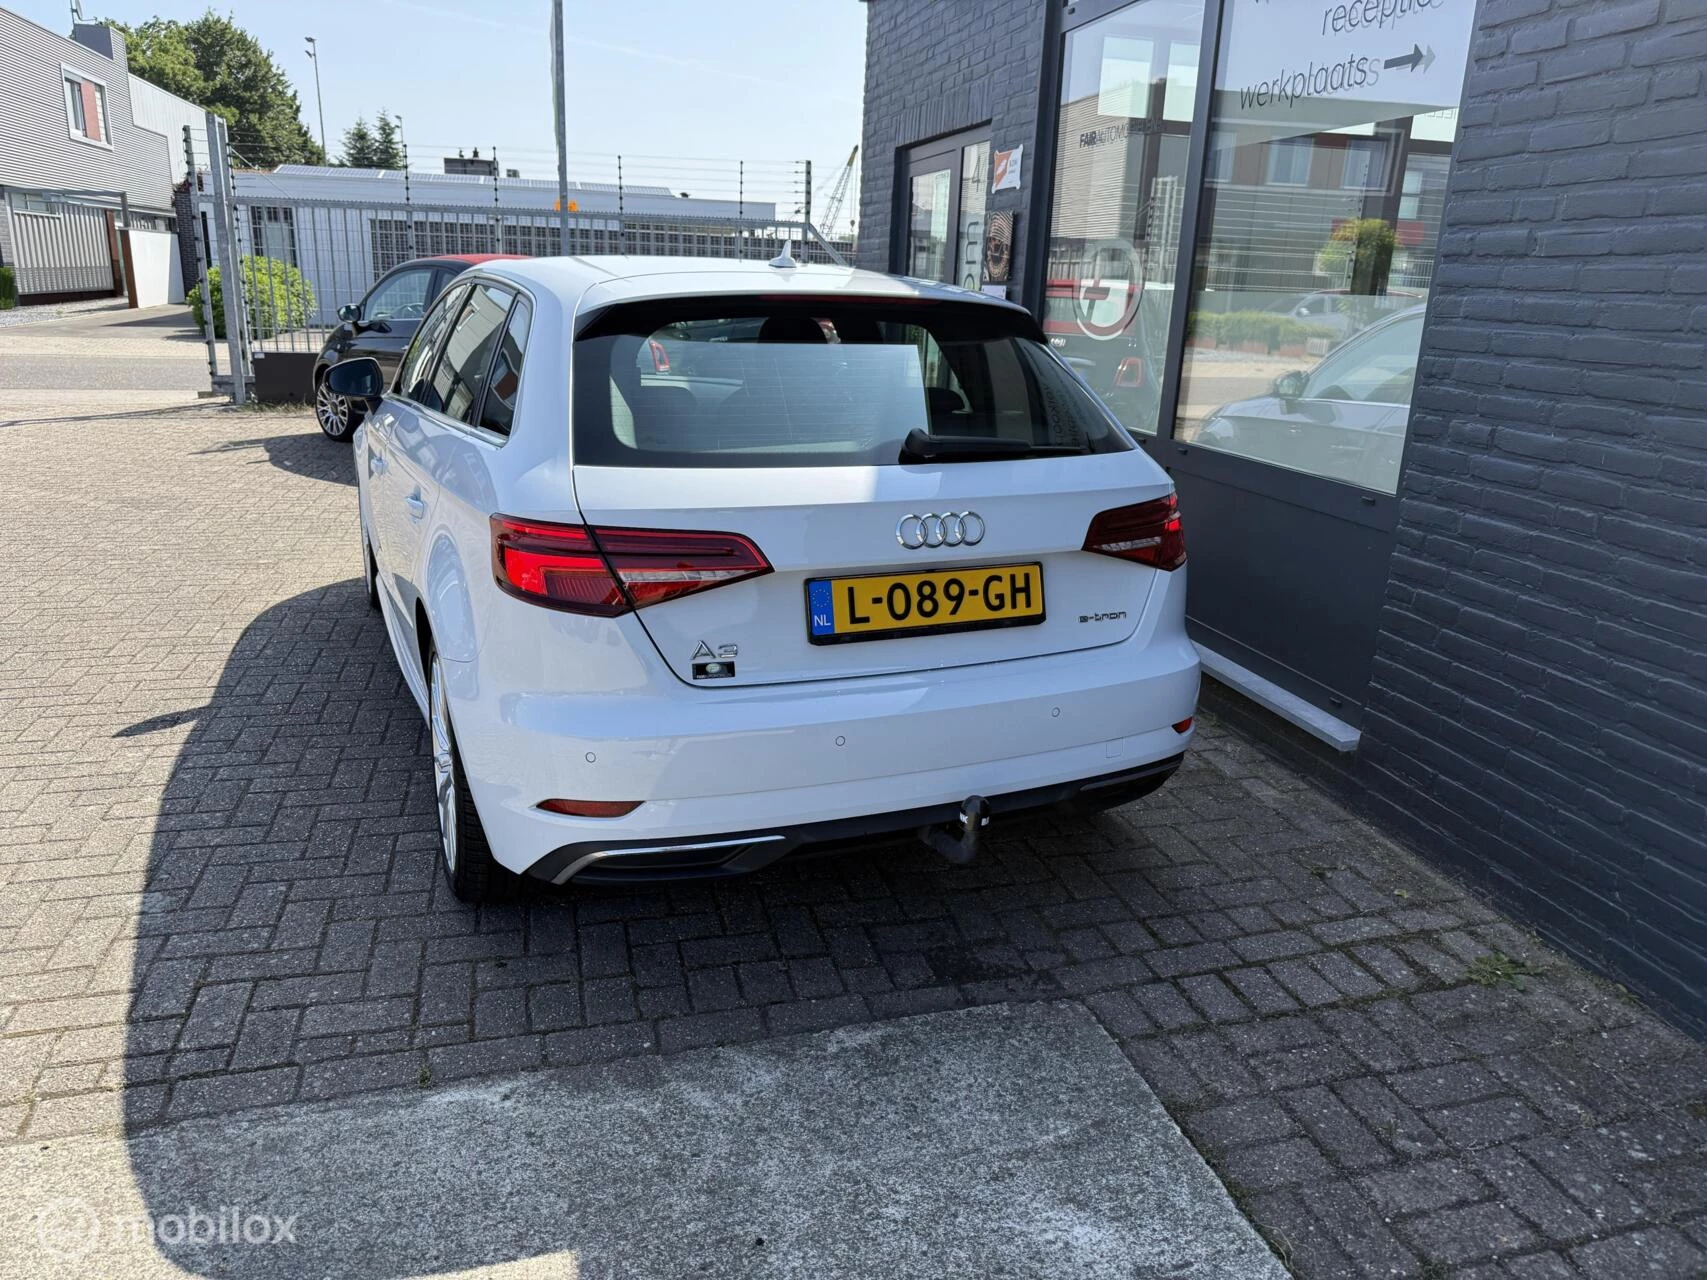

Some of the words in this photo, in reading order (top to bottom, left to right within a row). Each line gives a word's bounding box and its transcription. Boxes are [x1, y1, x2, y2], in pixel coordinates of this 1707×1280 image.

[1240, 53, 1368, 110] werkplaats
[847, 572, 1032, 625] L-089-GH
[814, 614, 831, 628] NL
[1079, 611, 1127, 623] e-tron
[690, 640, 738, 660] A3
